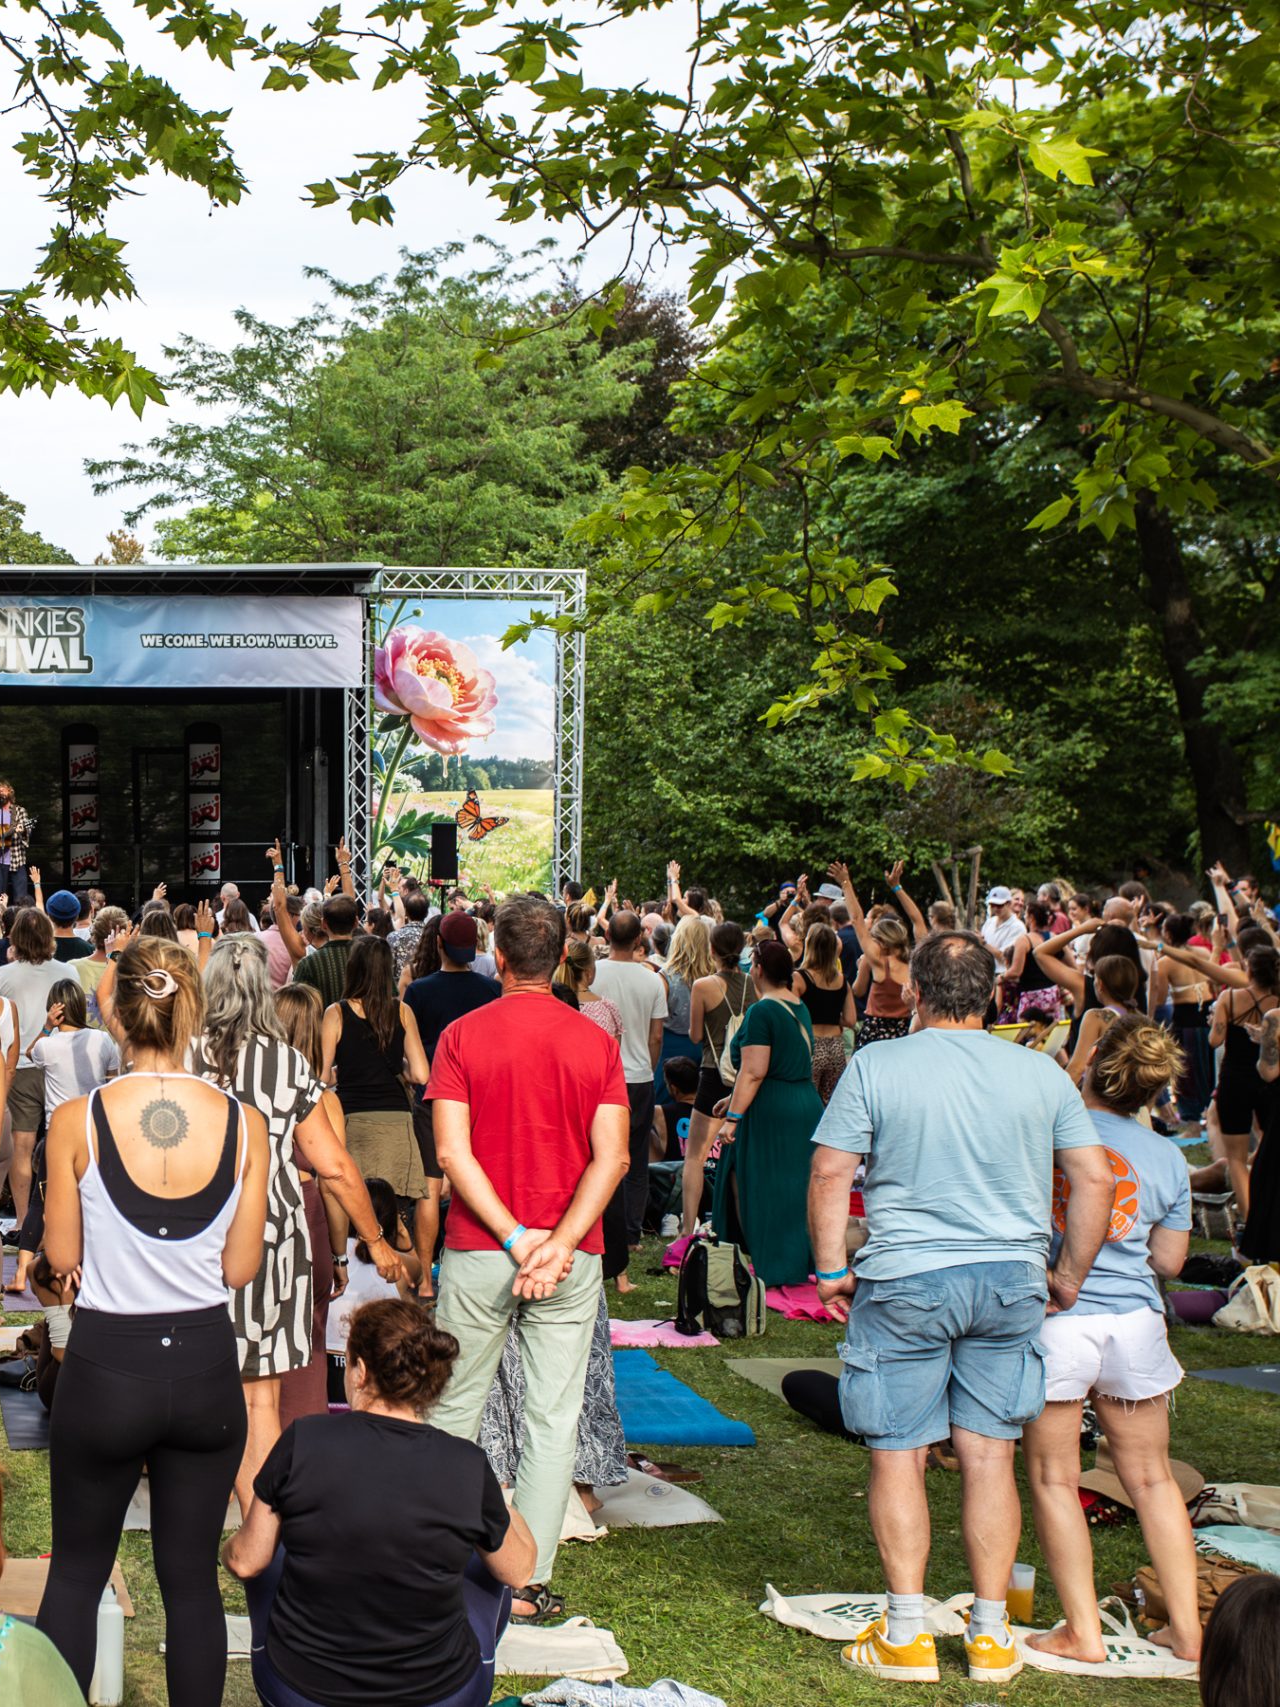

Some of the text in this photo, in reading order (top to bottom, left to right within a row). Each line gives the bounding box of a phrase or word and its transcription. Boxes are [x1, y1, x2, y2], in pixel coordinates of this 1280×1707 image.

[141, 634, 337, 647] WE COME. WE FLOW. WE LOVE.
